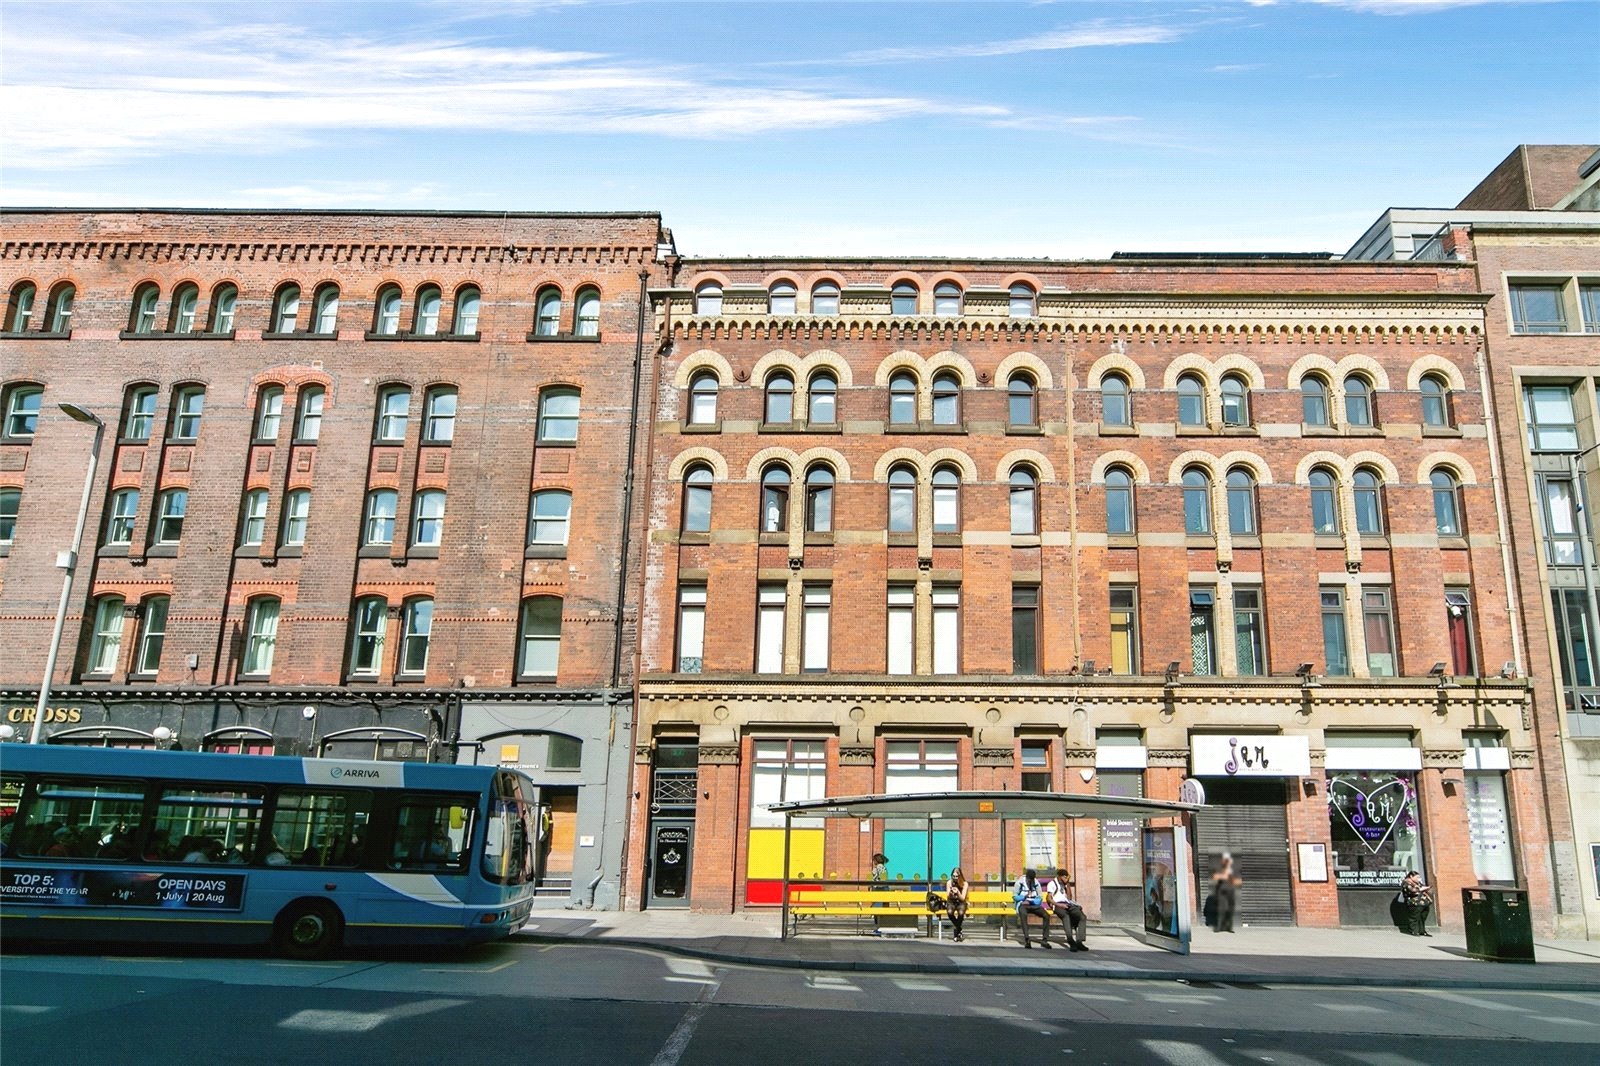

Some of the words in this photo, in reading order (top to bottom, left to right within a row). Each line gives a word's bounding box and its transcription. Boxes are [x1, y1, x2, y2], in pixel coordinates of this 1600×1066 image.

[343, 769, 380, 778] ARRIVA
[14, 874, 41, 886] TOP
[42, 875, 55, 886] 5:
[158, 878, 193, 890] OPEN
[194, 879, 227, 891] DAYS
[0, 885, 34, 893] VERSITY
[35, 886, 48, 894] OF
[65, 887, 89, 895] YEAR
[155, 892, 161, 900] 1
[162, 892, 183, 902] July
[192, 893, 205, 901] 20
[205, 893, 225, 903] Aug
